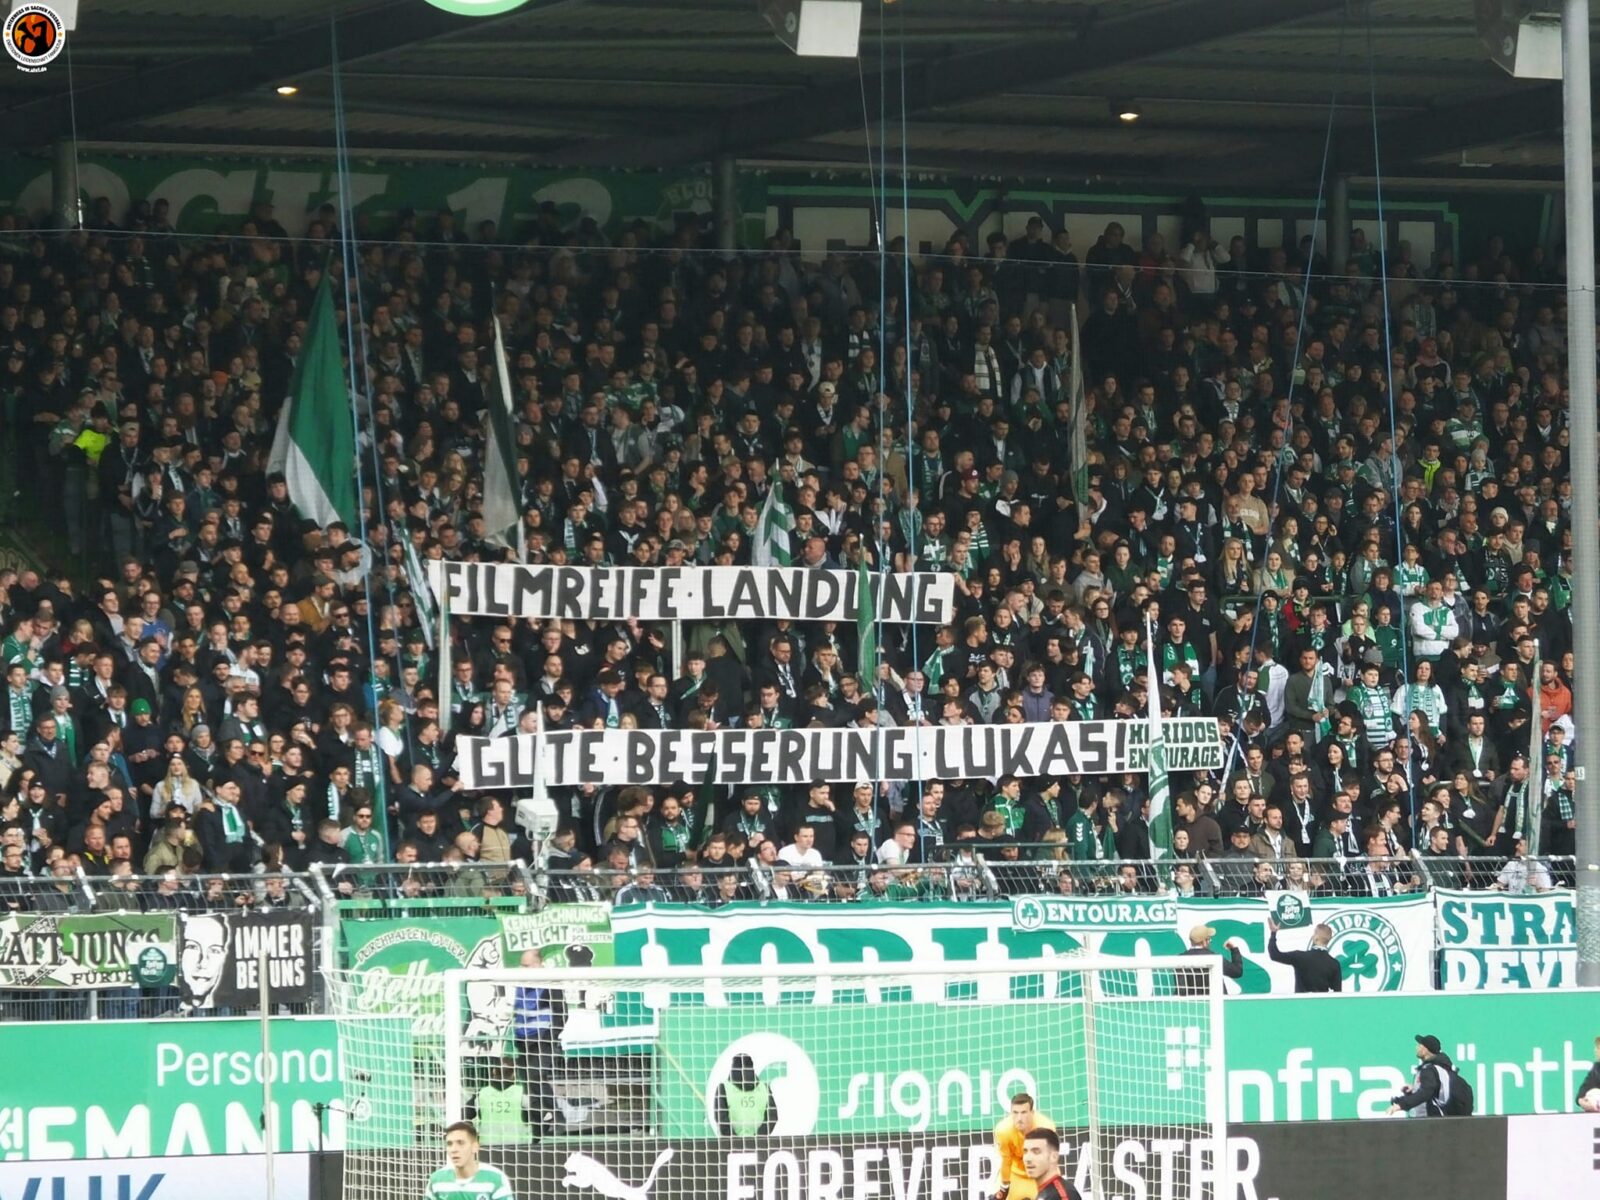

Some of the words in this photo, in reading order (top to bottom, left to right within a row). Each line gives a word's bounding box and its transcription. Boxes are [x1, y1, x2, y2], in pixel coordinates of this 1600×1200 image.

[445, 563, 682, 619] FILMREIFE
[702, 567, 943, 622] LANDUNG
[469, 731, 604, 788] GUTE
[626, 729, 913, 784] BESSERUNG
[934, 722, 1126, 779] LUKAS!
[1128, 745, 1221, 769] ENURAGE
[1046, 902, 1177, 923] ENTOURAGE
[235, 924, 304, 960] IMMER
[508, 926, 570, 949] PFLICHT
[269, 958, 305, 988] UNS
[156, 1038, 345, 1087] Personal
[489, 1101, 512, 1114] 152
[727, 1143, 1001, 1200] FOREVER
